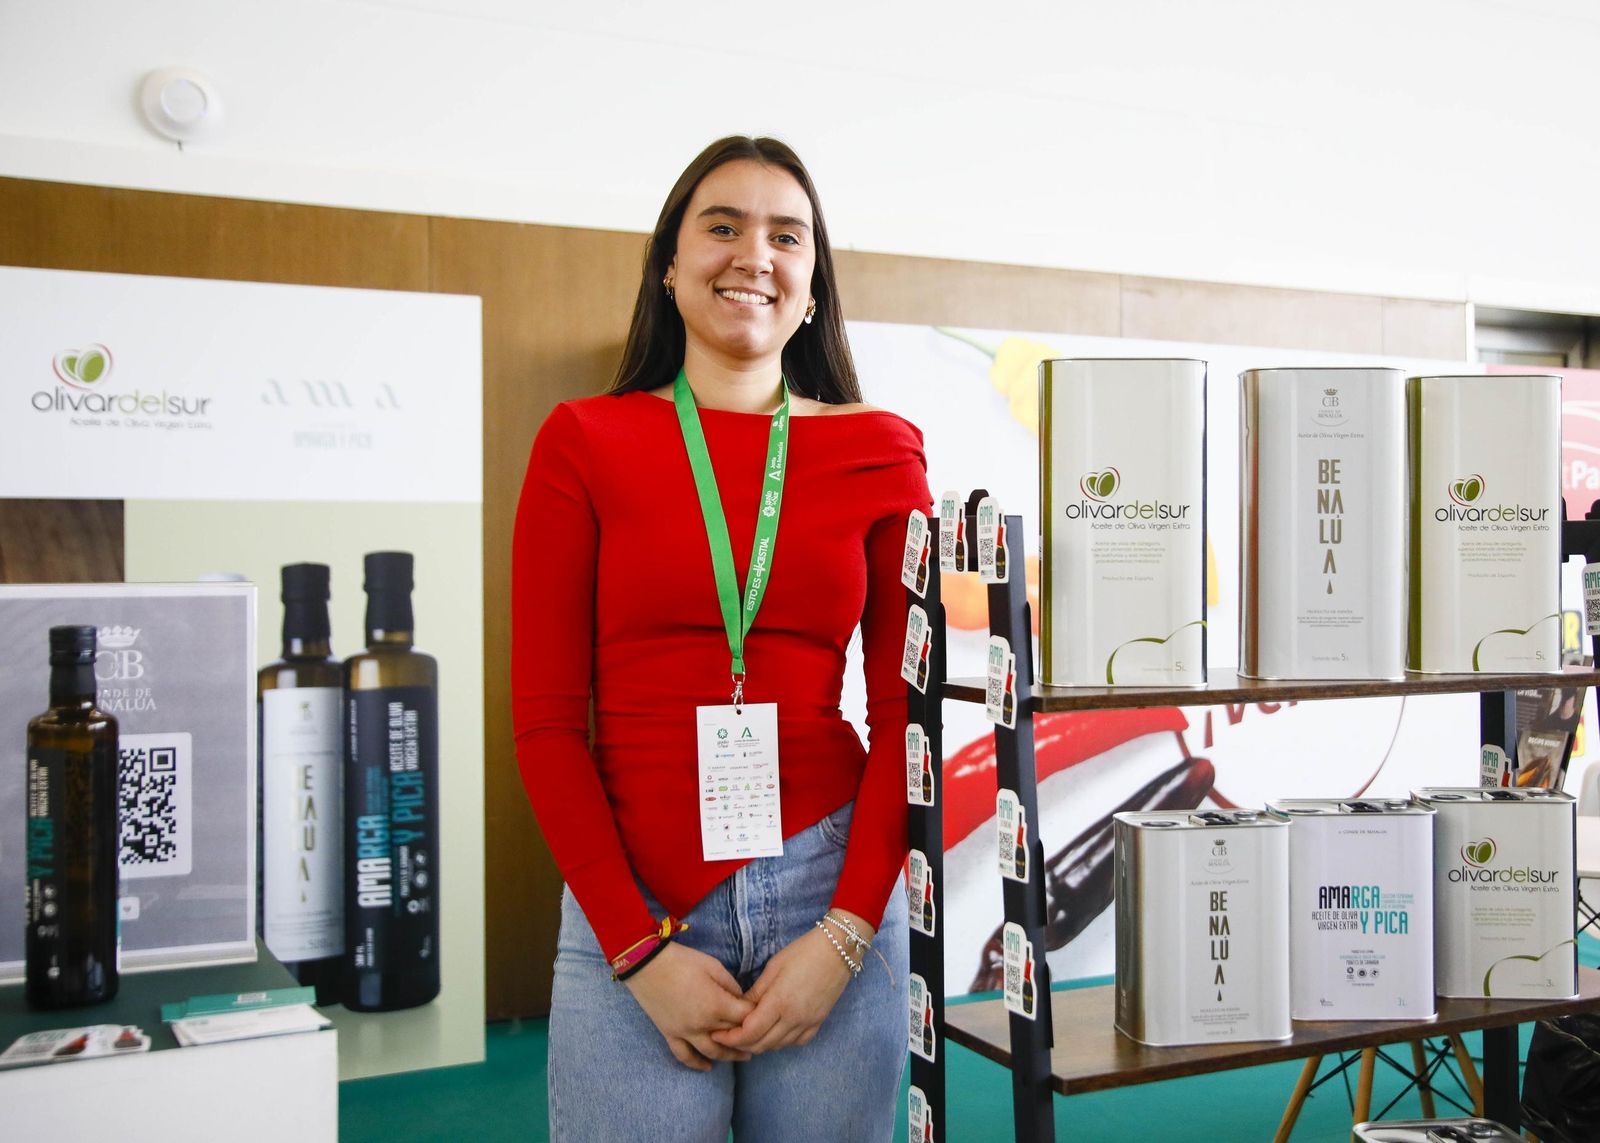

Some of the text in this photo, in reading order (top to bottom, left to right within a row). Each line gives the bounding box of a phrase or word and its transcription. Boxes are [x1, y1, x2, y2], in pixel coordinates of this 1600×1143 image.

[31, 386, 212, 416] olivardelsur
[1318, 459, 1341, 484] BE
[979, 505, 994, 526] AMA
[1065, 500, 1190, 520] olivardelsur
[1435, 504, 1549, 522] olivardelsur
[1091, 522, 1190, 532] Aceite de Oliva Virgen Extra
[752, 578, 762, 589] ES
[746, 589, 759, 611] ESTO
[1482, 750, 1499, 768] AMA
[391, 770, 425, 822] PICA
[998, 798, 1013, 821] AMA
[1448, 866, 1559, 883] olivardelsur
[1319, 885, 1380, 909] AMARGA
[1521, 885, 1541, 893] Virgen
[1210, 891, 1228, 912] BE
[1311, 910, 1358, 920] ACEITE DE OLIVA
[1318, 920, 1358, 930] VIRGEN EXTRA
[1360, 910, 1408, 934] Y PICA
[1005, 929, 1020, 954] AMA
